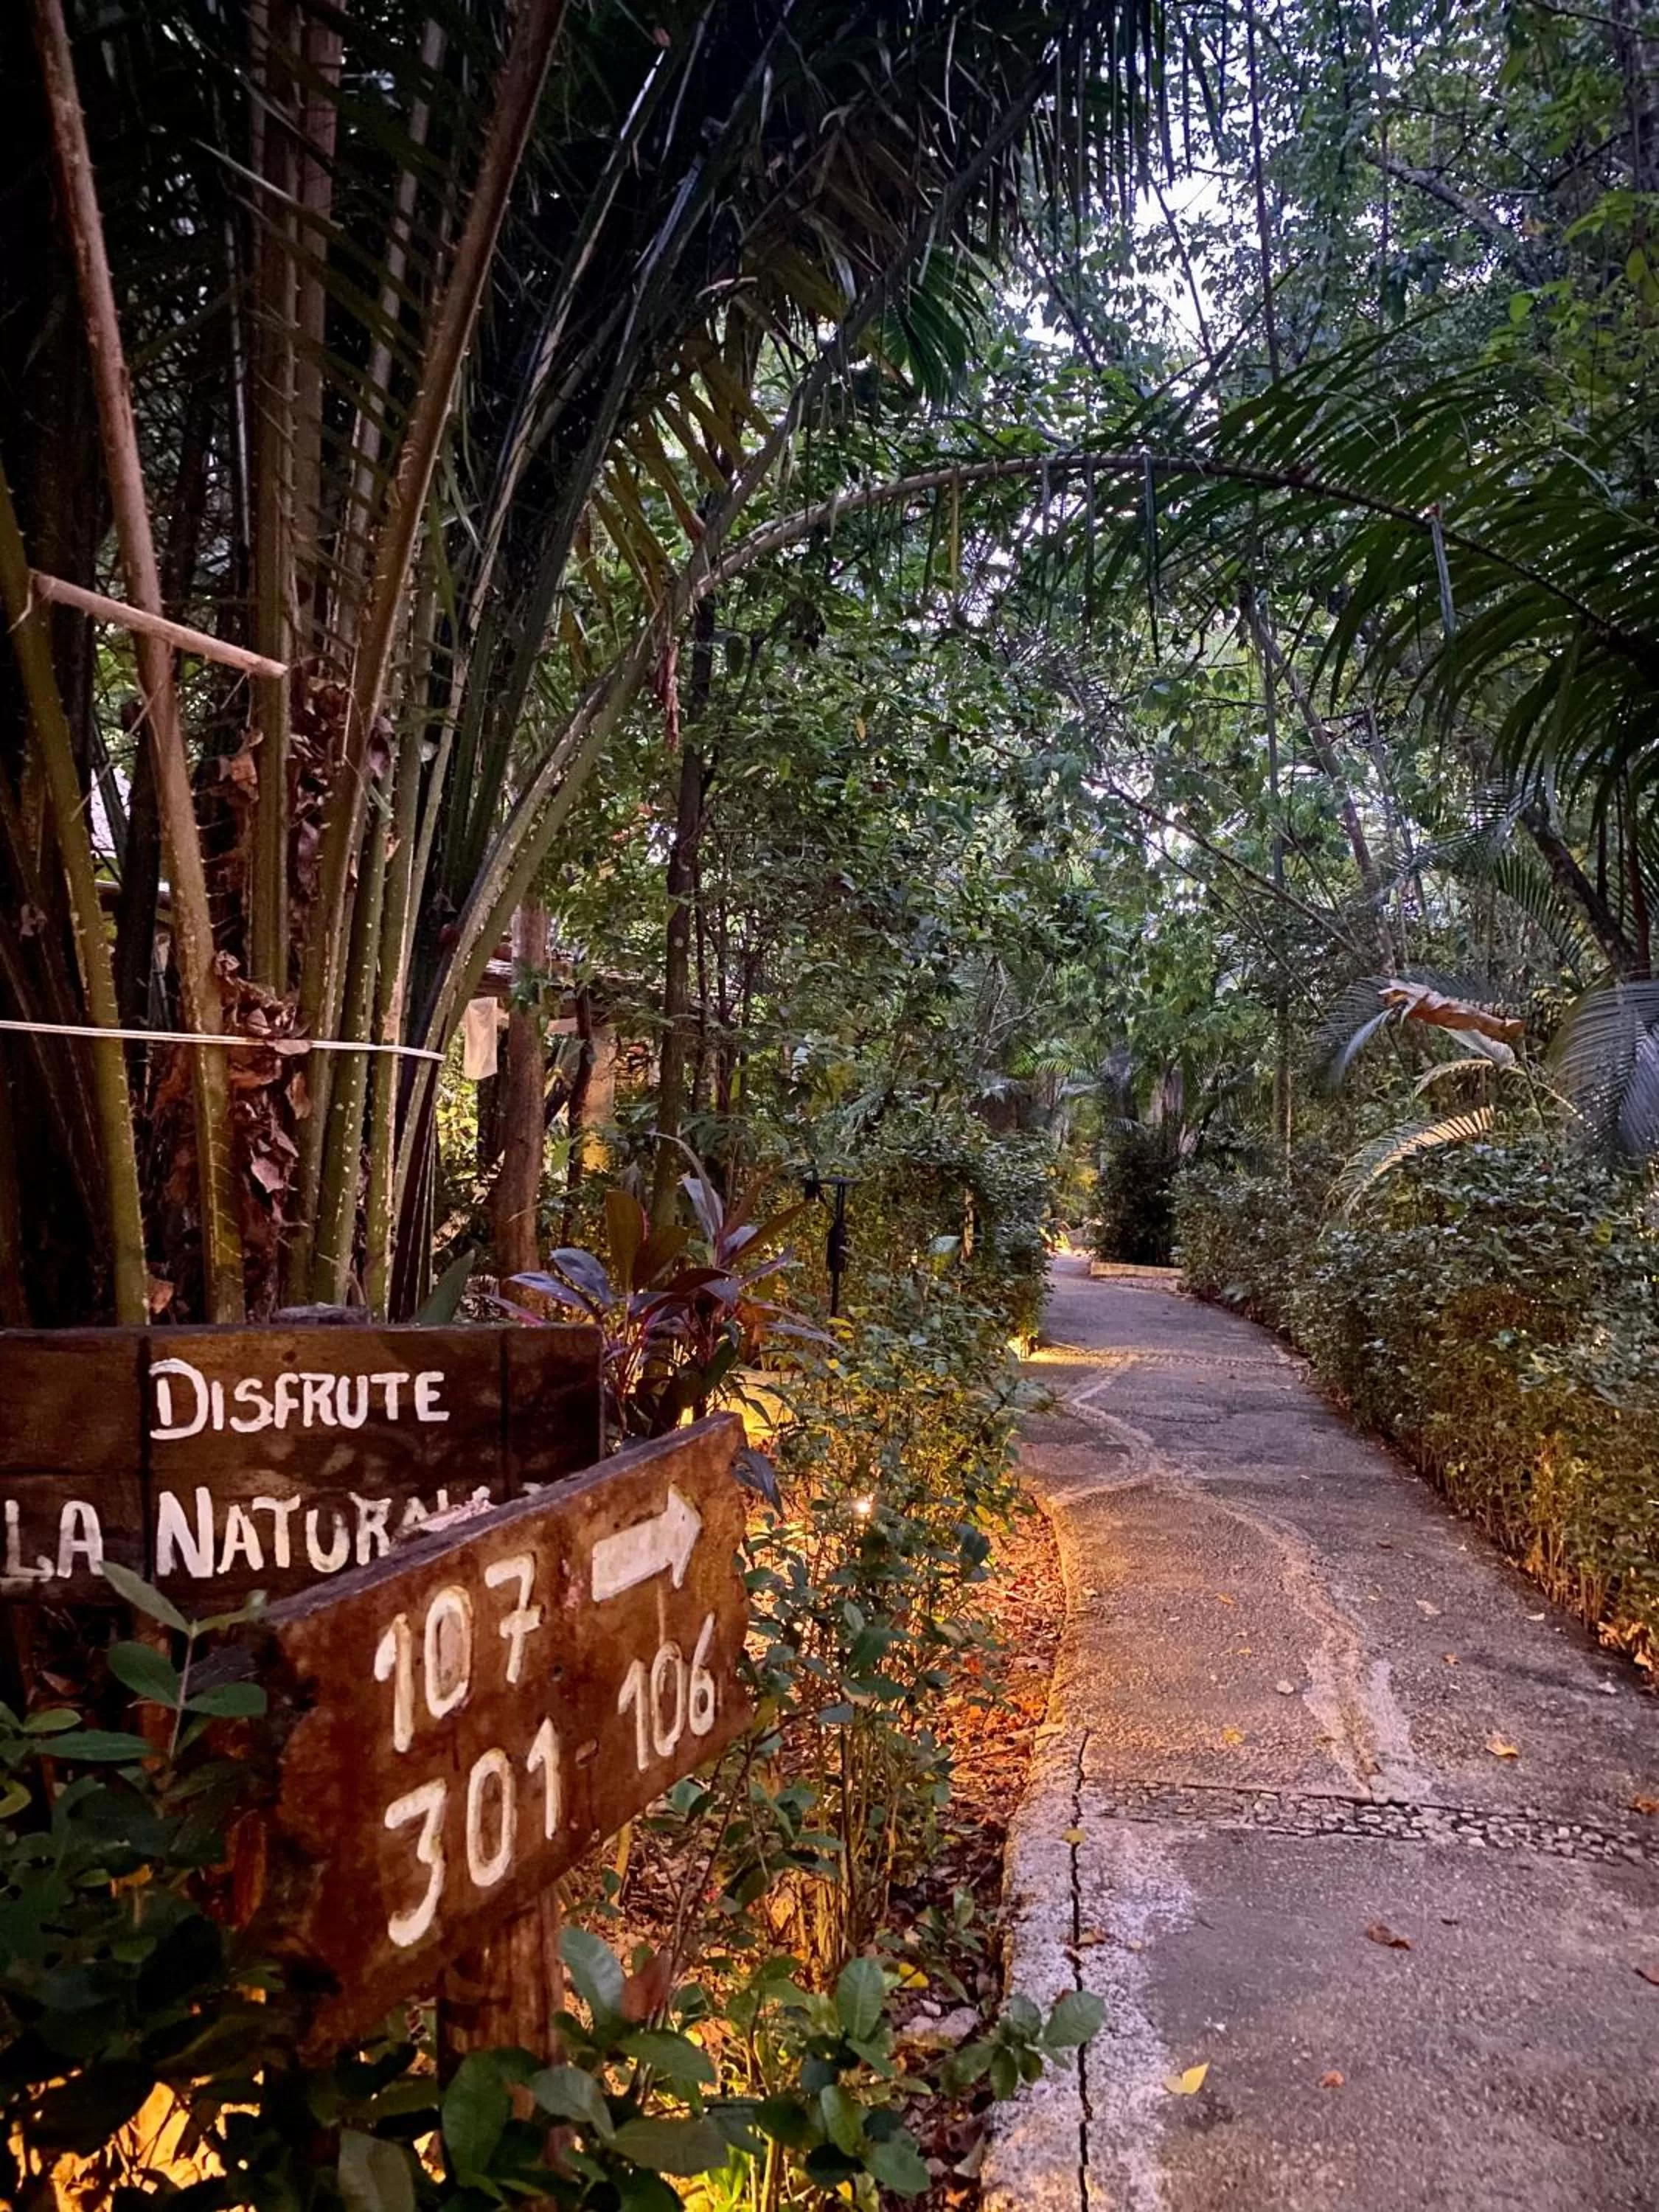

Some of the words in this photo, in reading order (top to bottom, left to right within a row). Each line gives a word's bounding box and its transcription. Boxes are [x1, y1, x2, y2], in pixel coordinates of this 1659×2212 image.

[150, 1358, 450, 1440] DISFRUTE
[5, 1499, 105, 1582] LA
[374, 1551, 542, 1753] 107
[385, 1717, 561, 1947] 301
[617, 1612, 716, 1773] 106
